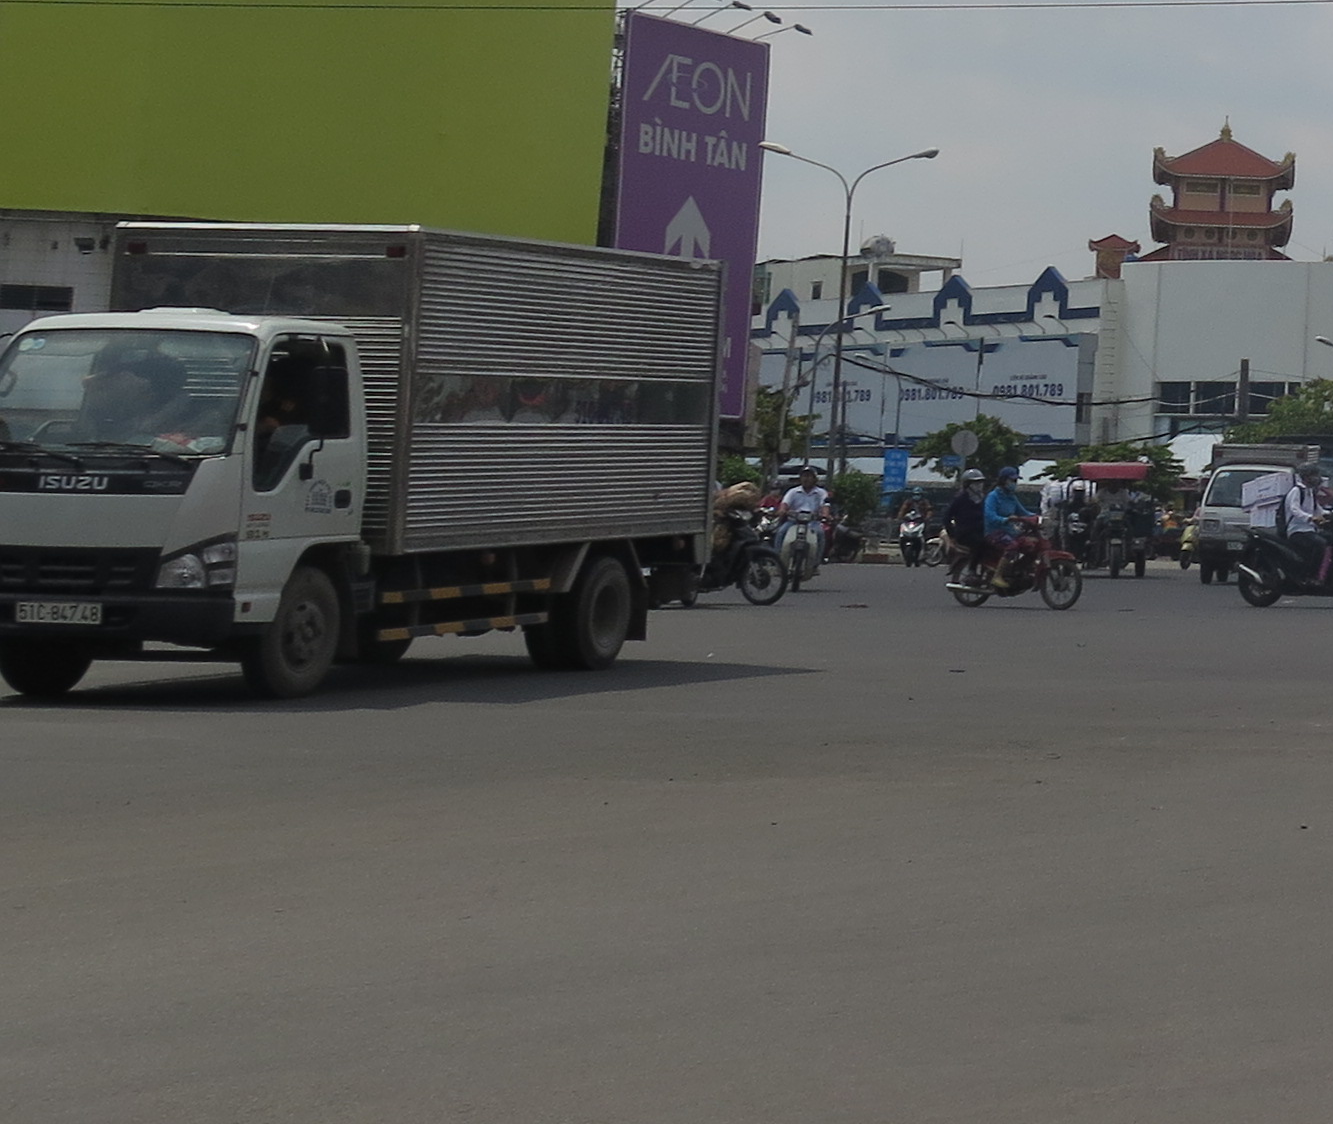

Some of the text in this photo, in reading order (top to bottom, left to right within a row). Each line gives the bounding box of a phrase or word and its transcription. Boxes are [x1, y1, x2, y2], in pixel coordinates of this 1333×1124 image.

[639, 117, 748, 171] BÌNH TÂN
[39, 476, 109, 490] ISUZU
